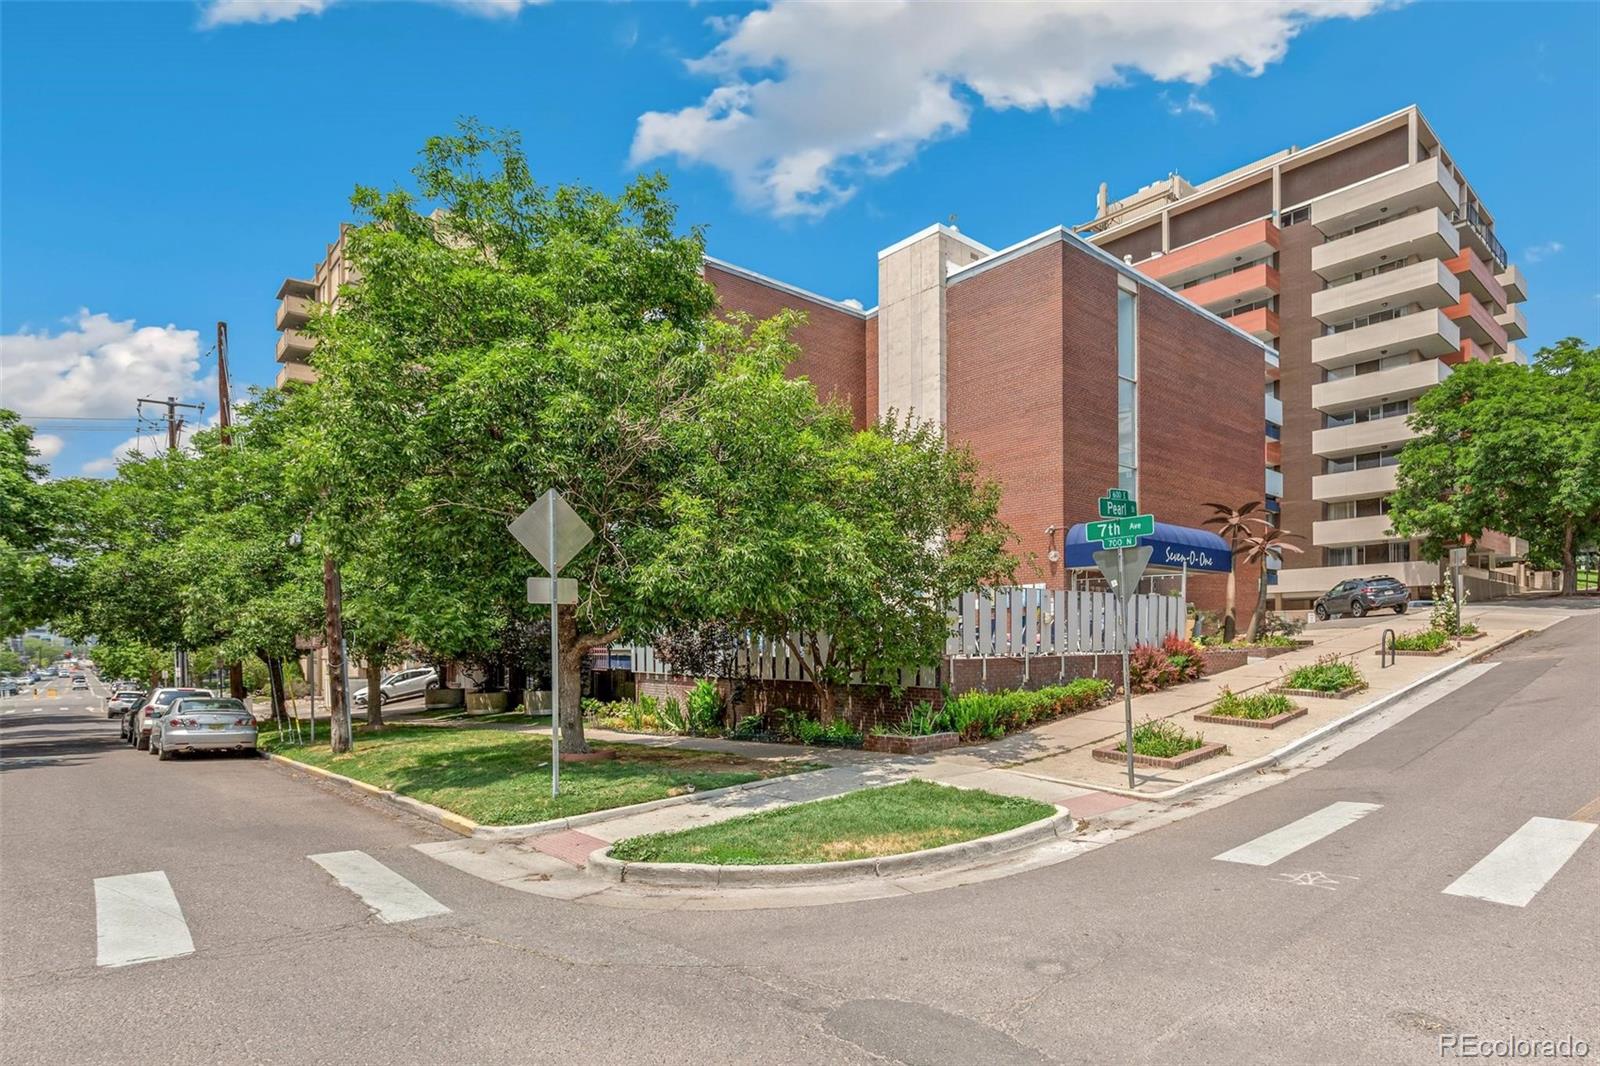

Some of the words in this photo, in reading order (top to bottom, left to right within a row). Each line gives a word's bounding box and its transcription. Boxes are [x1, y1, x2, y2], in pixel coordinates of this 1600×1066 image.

[1108, 502, 1126, 516] Pearl
[1096, 522, 1120, 538] 7th
[1108, 538, 1122, 547] 700
[1165, 545, 1214, 567] Seven-O-One
